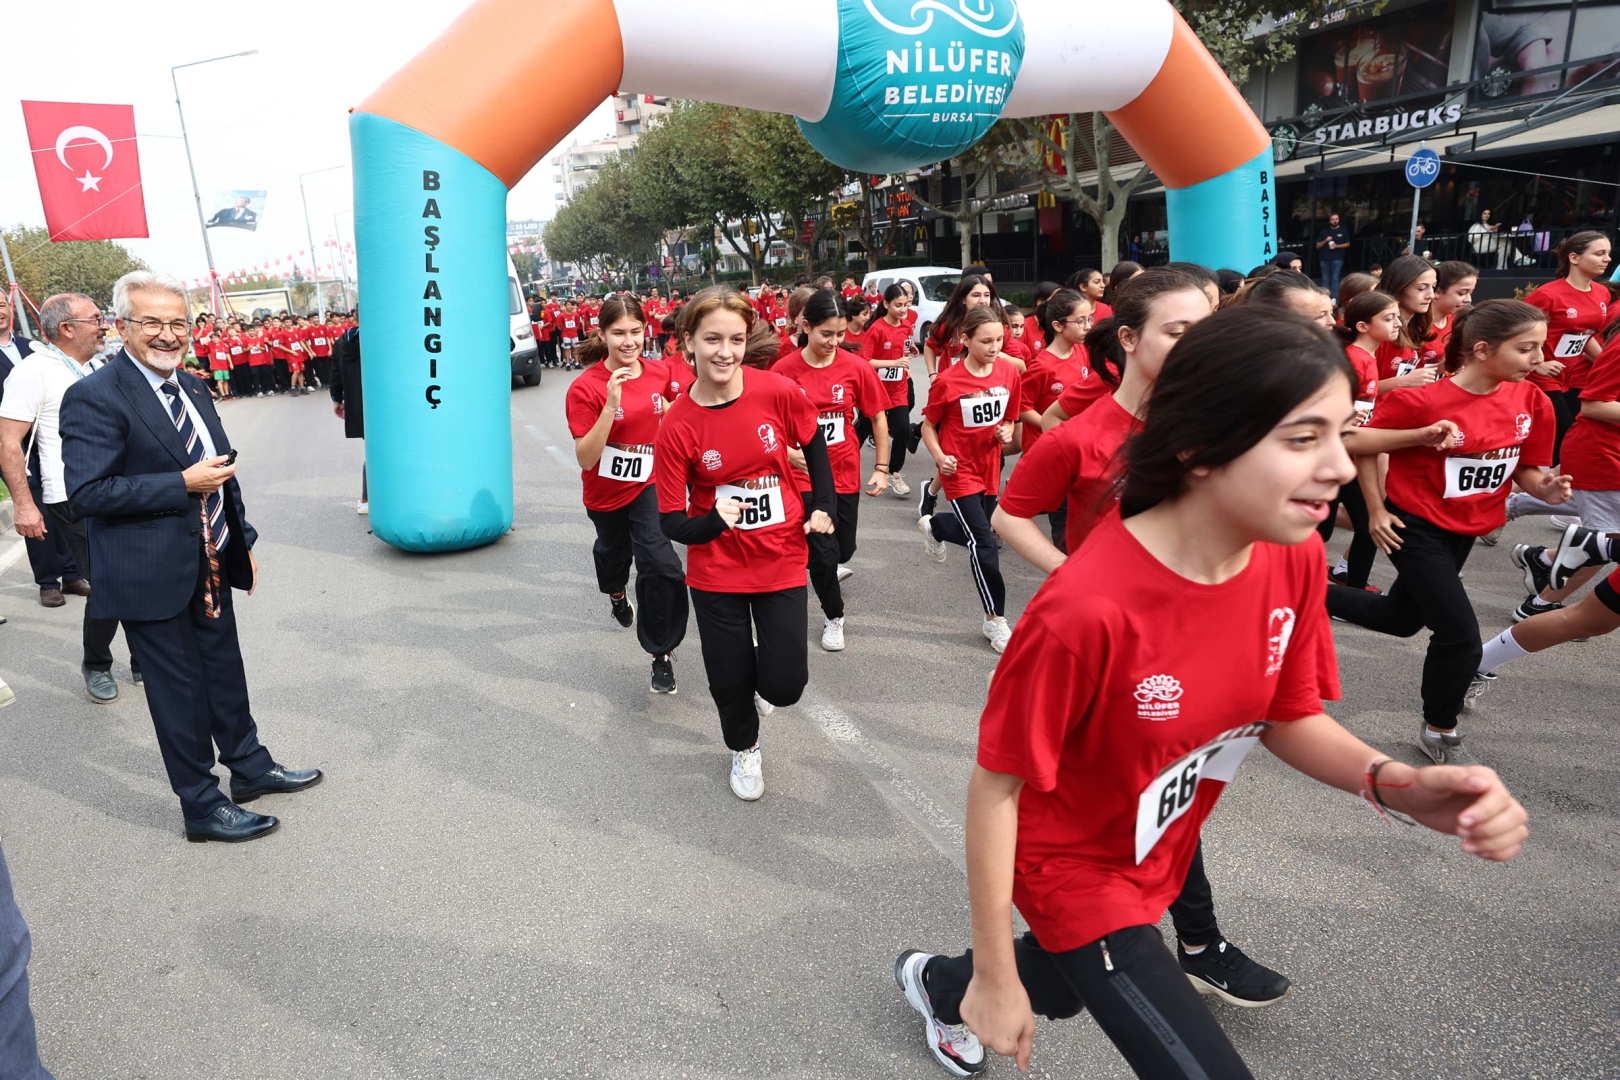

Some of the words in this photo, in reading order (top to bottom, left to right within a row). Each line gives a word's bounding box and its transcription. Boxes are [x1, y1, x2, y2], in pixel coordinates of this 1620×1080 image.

[886, 40, 1011, 77] NİLÜFER
[884, 79, 1007, 105] BELEDİYESİ
[932, 112, 973, 123] BURSA
[1314, 103, 1462, 144] STARBUCKS
[422, 170, 442, 409] BAŞLANGIÇ
[884, 367, 899, 379] 731
[972, 400, 1001, 424] 694
[611, 456, 642, 478] 670
[1458, 463, 1507, 491] 689
